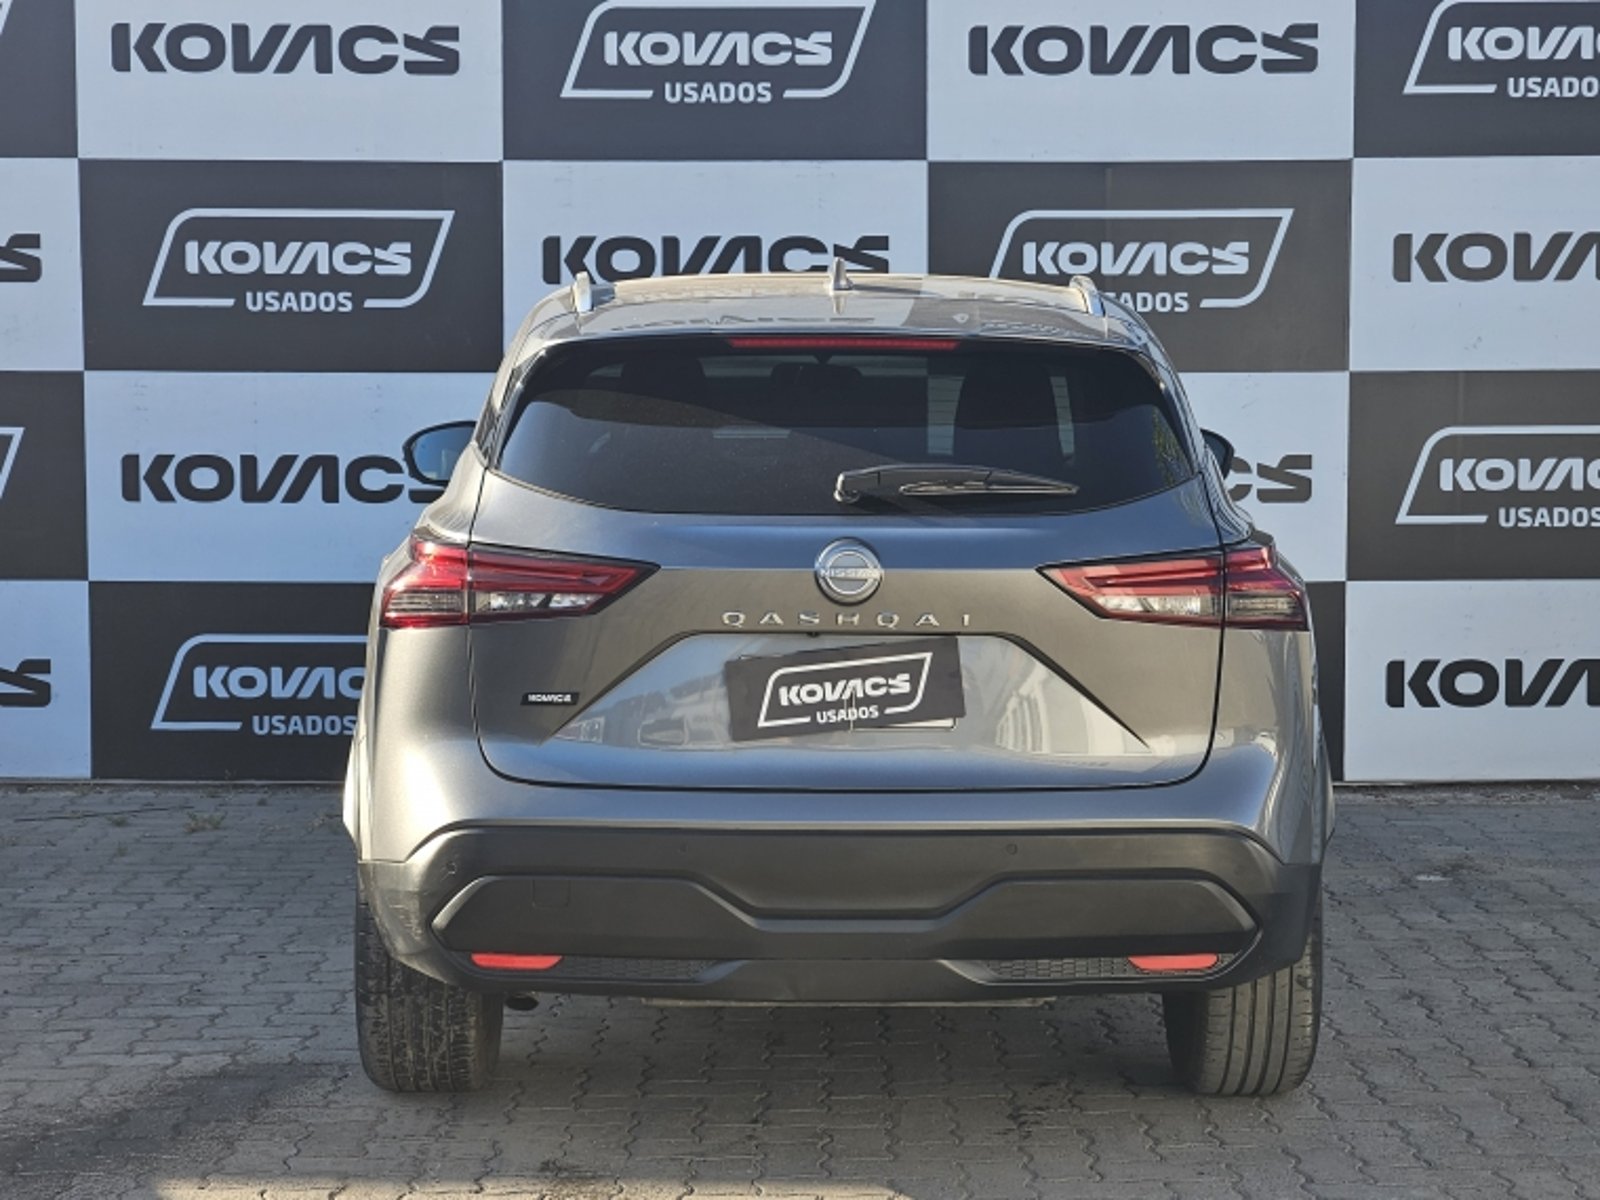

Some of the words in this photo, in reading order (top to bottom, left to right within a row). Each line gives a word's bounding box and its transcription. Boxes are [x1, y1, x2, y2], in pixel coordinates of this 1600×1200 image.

[111, 23, 460, 75] KOVACS
[604, 31, 833, 66] KOVACS
[968, 23, 1319, 75] KOVACS
[1447, 26, 1600, 61] KOVA
[664, 81, 772, 103] USADOS
[1507, 76, 1600, 98] USADO
[184, 240, 412, 275] KOVACS
[542, 235, 889, 285] KOVACS
[1022, 241, 1250, 276] KOVACS
[1392, 231, 1600, 283] KOVA
[245, 291, 353, 312] USADOS
[1103, 291, 1190, 313] ADOS
[721, 611, 970, 628] QASHQAI
[778, 672, 911, 707] KOVACS
[1385, 658, 1600, 708] KOVA
[816, 705, 879, 724] USADOS
